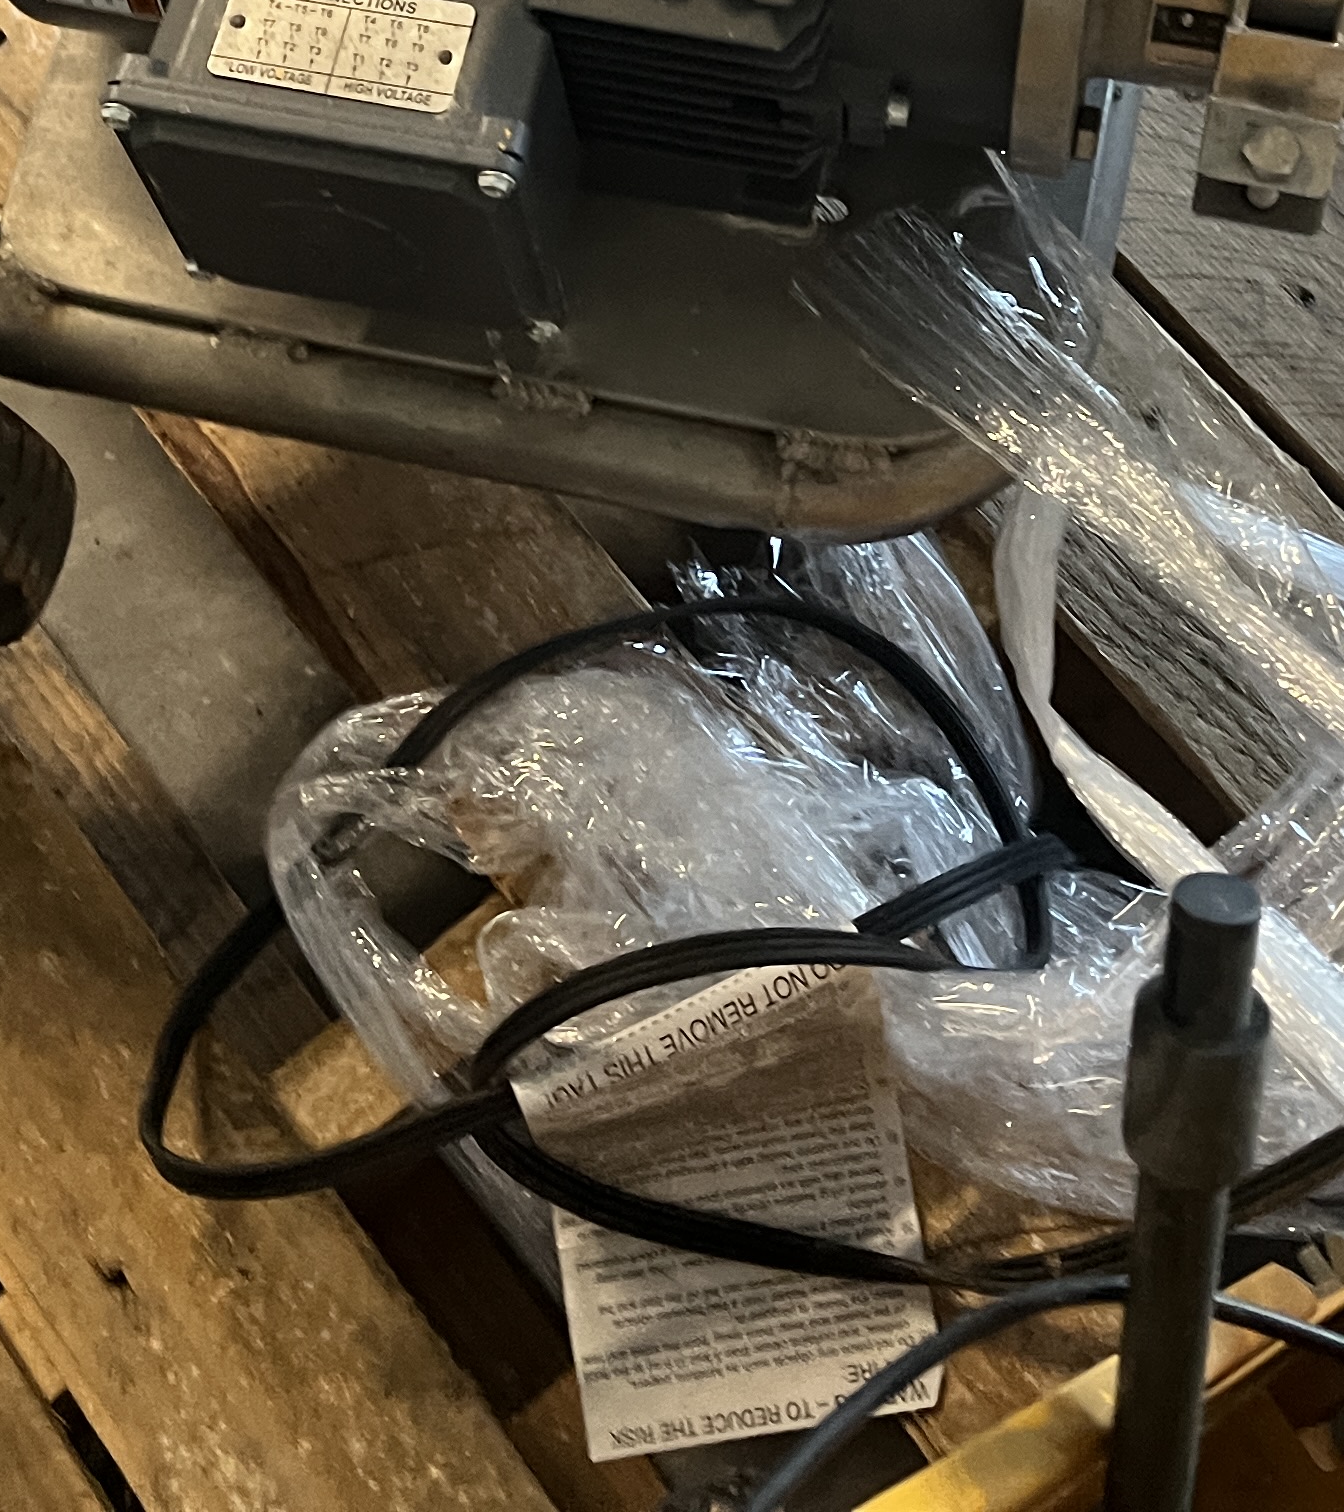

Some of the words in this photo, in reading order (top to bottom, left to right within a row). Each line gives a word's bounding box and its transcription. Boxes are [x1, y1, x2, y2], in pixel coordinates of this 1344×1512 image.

[228, 63, 256, 75] LOW
[343, 83, 374, 95] HIGH
[377, 88, 432, 106] VOLTAGE
[761, 968, 810, 1009] NOT
[658, 991, 759, 1060] REMOVE
[602, 1043, 659, 1083] THIS
[704, 1403, 781, 1436] REDUCE
[785, 1399, 816, 1422] TO
[659, 1416, 696, 1443] THE
